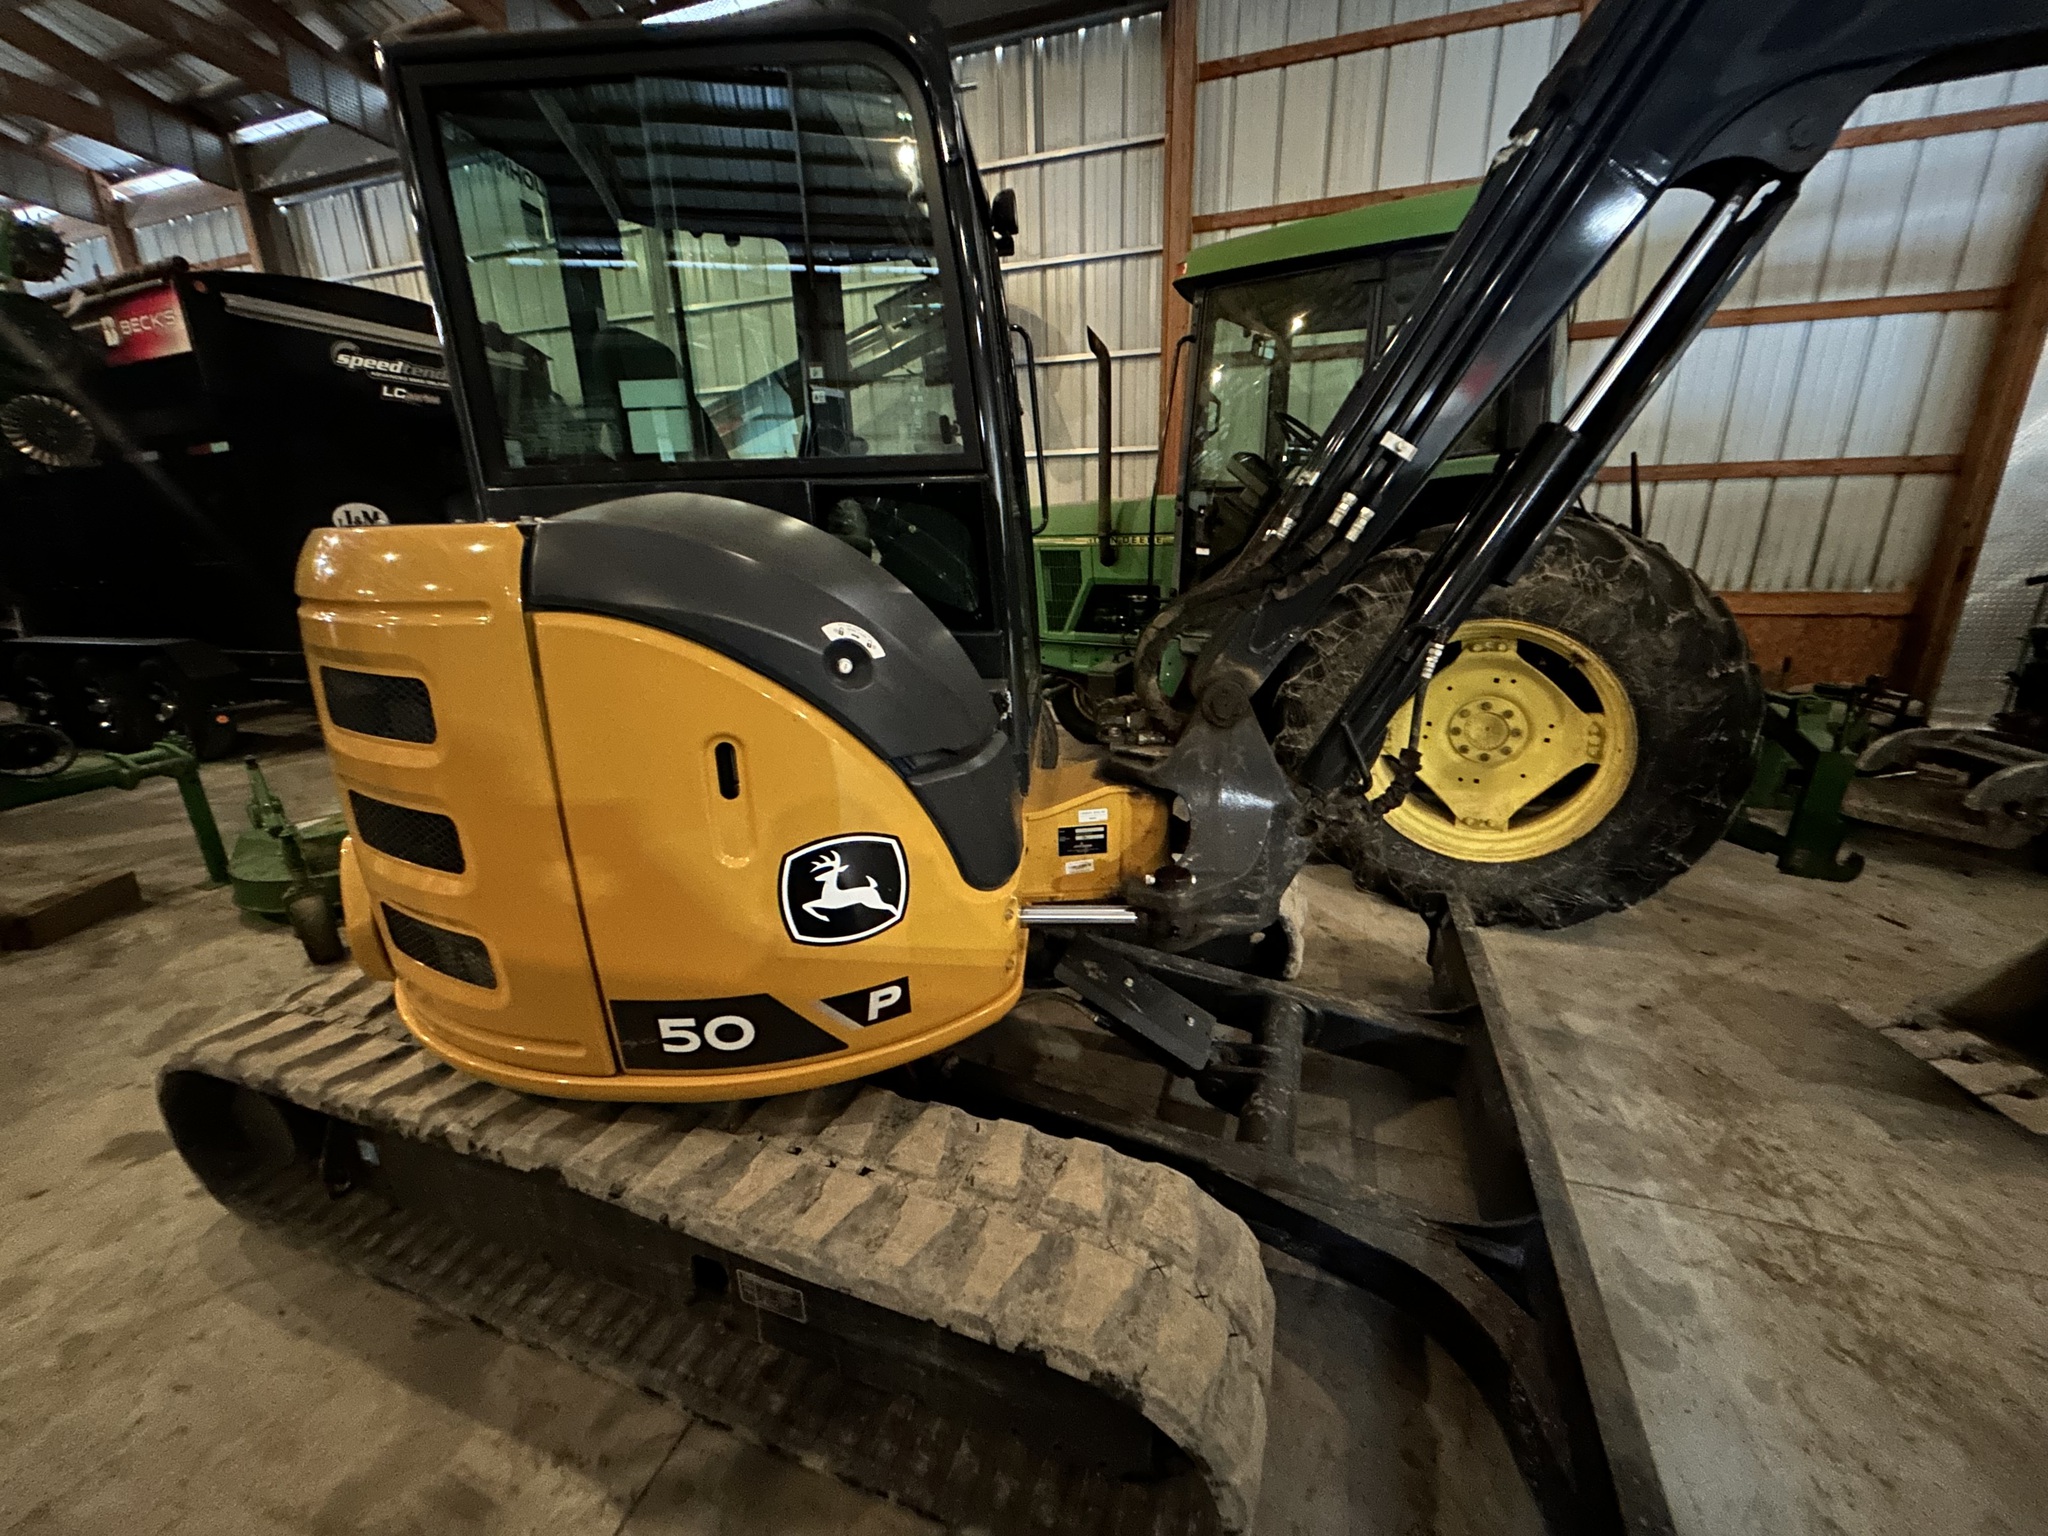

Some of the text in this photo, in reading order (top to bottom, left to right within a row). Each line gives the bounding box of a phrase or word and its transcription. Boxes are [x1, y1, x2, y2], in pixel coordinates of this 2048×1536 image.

[1122, 536, 1163, 544] DEEE
[657, 985, 902, 1053] 50 P
